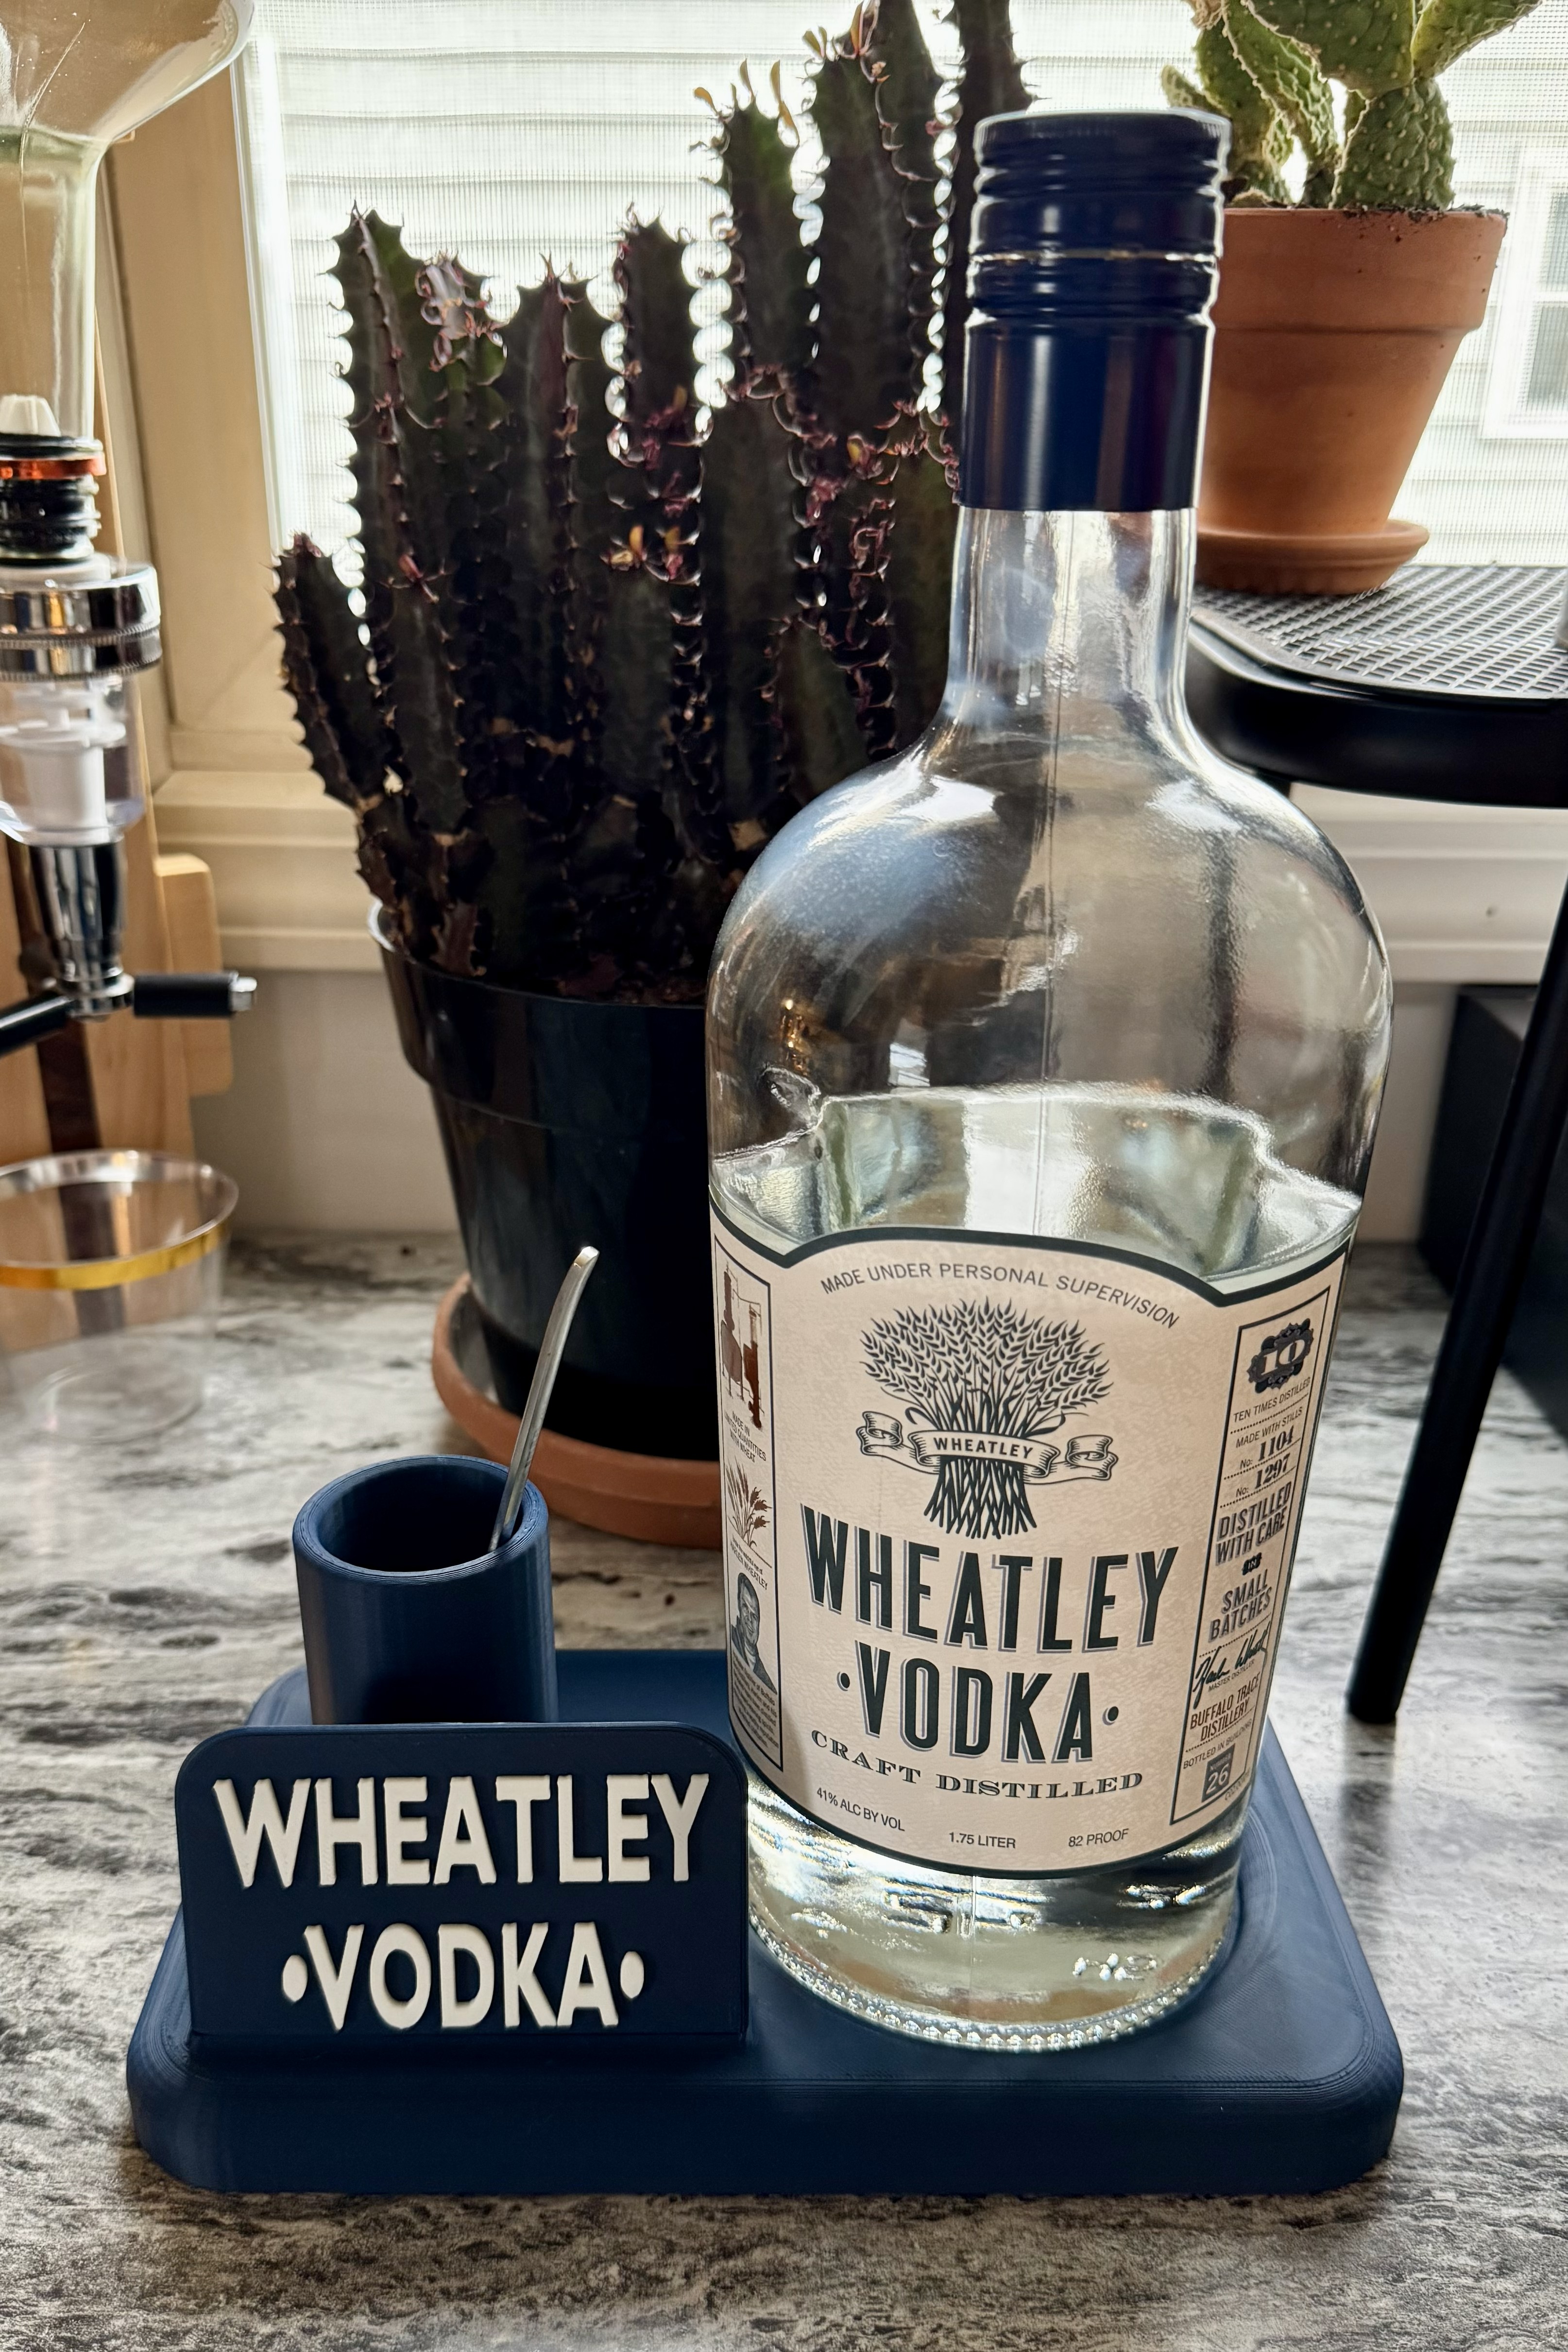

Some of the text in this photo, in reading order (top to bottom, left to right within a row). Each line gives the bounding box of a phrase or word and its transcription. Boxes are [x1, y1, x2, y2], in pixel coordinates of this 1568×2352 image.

[821, 1263, 1180, 1329] MADE UNDER PERSONAL SUPERVISION
[1261, 1339, 1305, 1375] 10
[1233, 1377, 1311, 1423] TEN TIMES DISTILLED
[737, 1428, 766, 1461] QUANTITIES
[933, 1437, 1033, 1459] WHEATLEY
[1236, 1407, 1303, 1448] MADE WITH STILLS
[1258, 1425, 1294, 1461] 1104
[1255, 1452, 1290, 1489] 1297
[1217, 1481, 1292, 1542] DISTILLED
[1215, 1506, 1287, 1566] WITH CARE
[744, 1560, 767, 1590] WHEATLEY
[800, 1503, 1178, 1654] WHEATLEY
[1221, 1569, 1268, 1614] SMALL
[1208, 1586, 1272, 1643] BATCHES
[1190, 1695, 1234, 1730] BUFFALO
[1237, 1671, 1260, 1704] TRACE
[1208, 1676, 1230, 1692] MASTER
[1200, 1697, 1249, 1741] DISTILLERY
[812, 1730, 1143, 1799] CRAFT DISTILLED
[1183, 1747, 1216, 1769] BOTTLED
[1217, 1742, 1225, 1751] IN
[1206, 1763, 1229, 1795] 26
[213, 1773, 709, 1888] WHEATLEY
[817, 1787, 905, 1832] 41% ALC BY VOL
[949, 1832, 1016, 1848] 1.75 LITER
[1069, 1828, 1129, 1847] 82 PROOF
